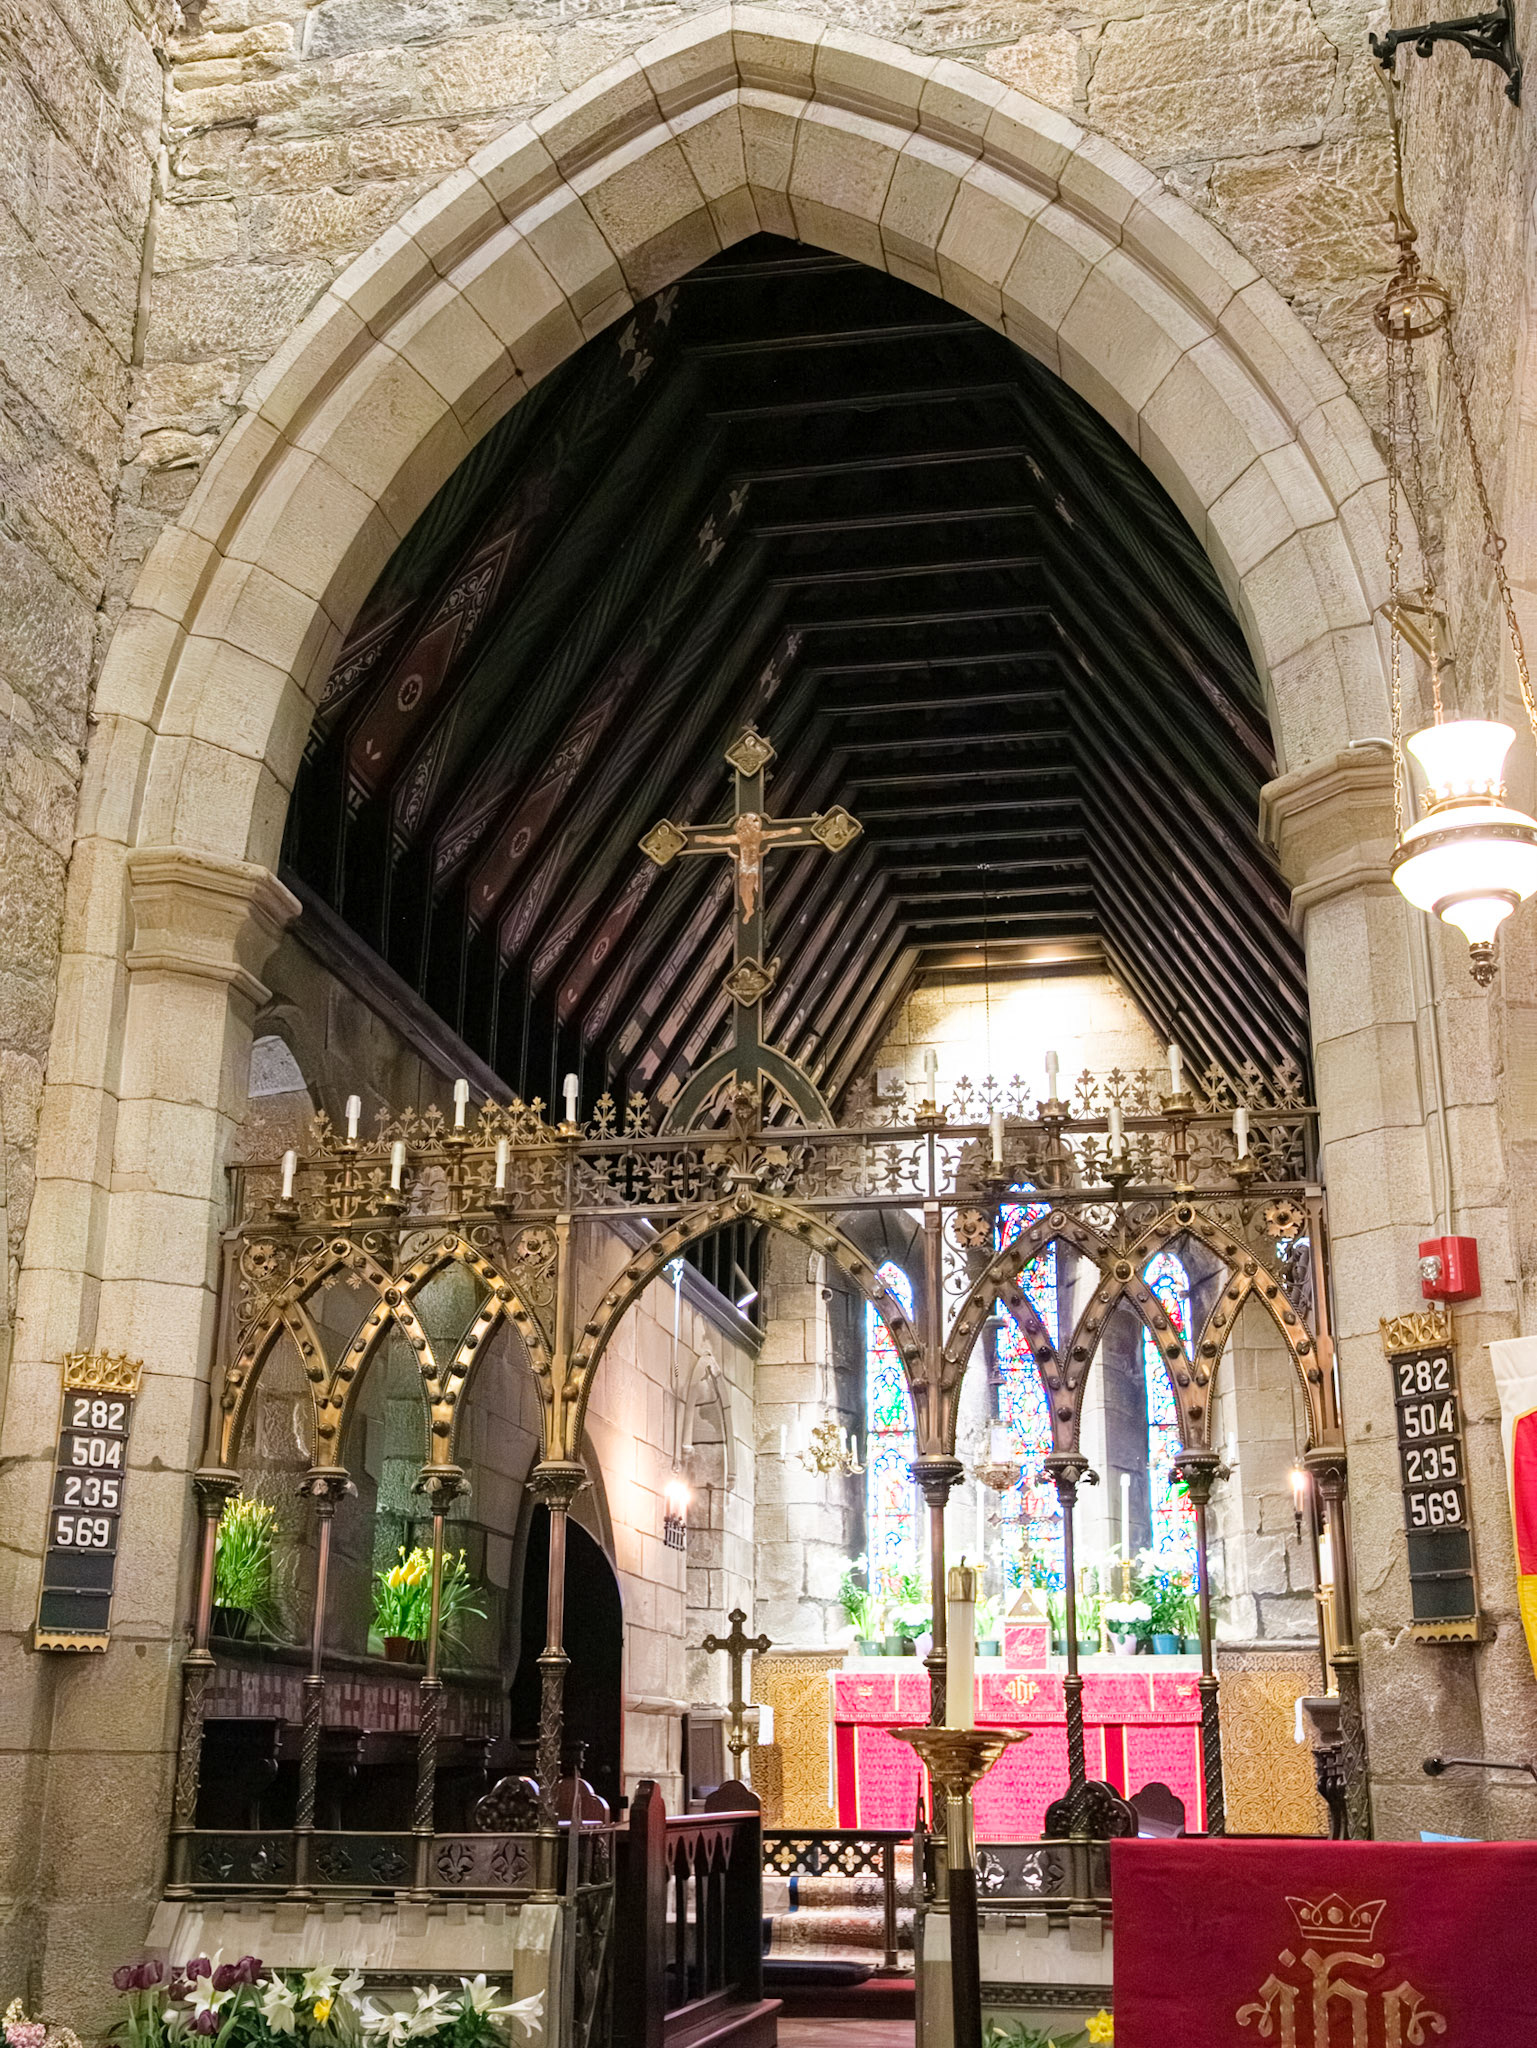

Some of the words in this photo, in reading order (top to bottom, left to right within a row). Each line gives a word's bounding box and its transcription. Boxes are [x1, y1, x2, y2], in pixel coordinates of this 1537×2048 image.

[1399, 1358, 1450, 1396] 282
[72, 1398, 125, 1431] 282
[1404, 1401, 1453, 1438] 504
[72, 1436, 121, 1469] 504
[1406, 1445, 1457, 1483] 235
[64, 1476, 119, 1508] 235
[1410, 1489, 1461, 1526] 569
[56, 1515, 110, 1547] 569
